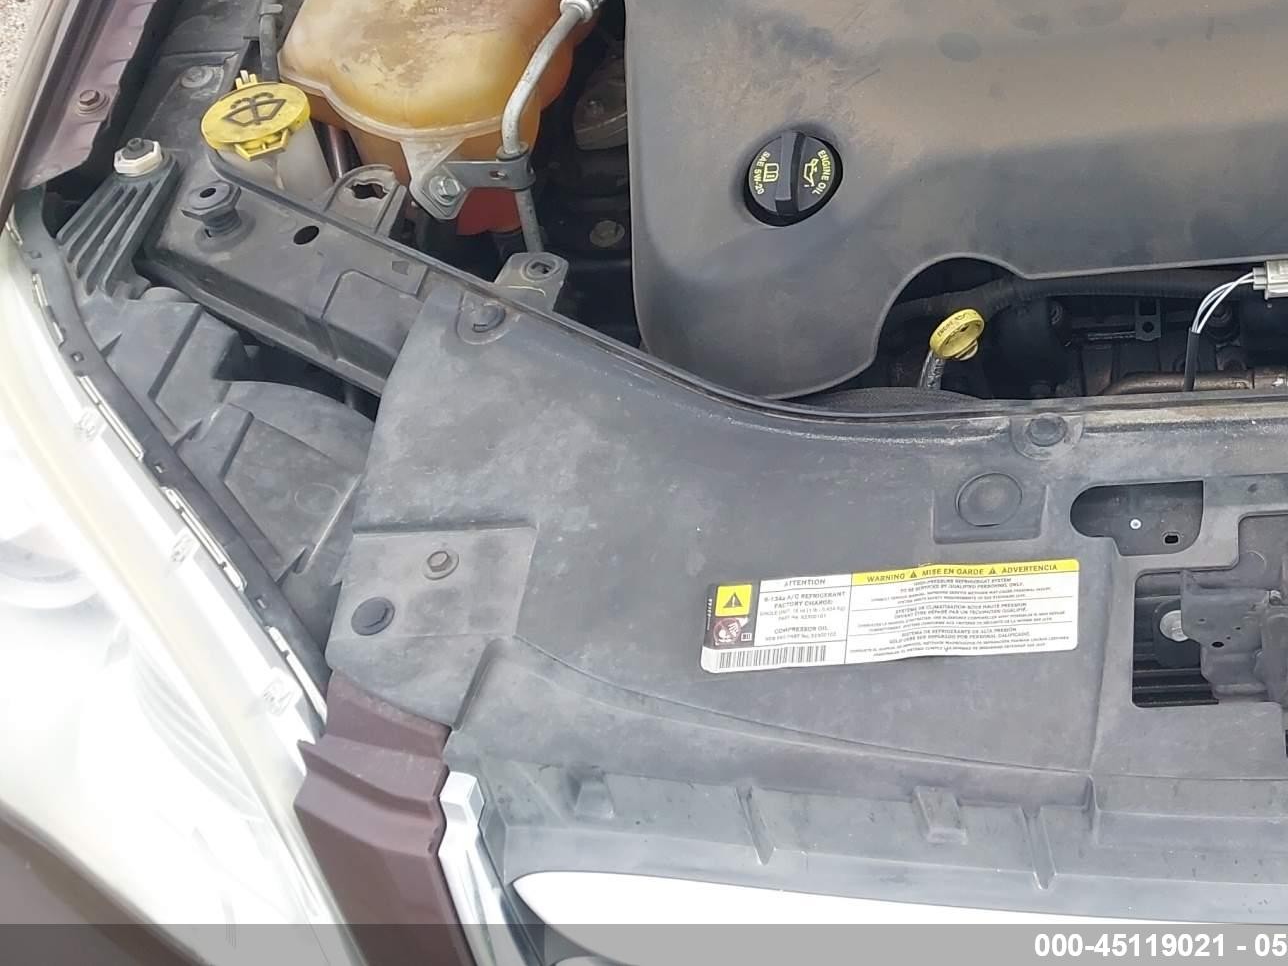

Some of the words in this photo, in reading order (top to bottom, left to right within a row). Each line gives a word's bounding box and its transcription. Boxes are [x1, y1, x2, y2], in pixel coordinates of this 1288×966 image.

[756, 151, 771, 167] SAE
[817, 150, 832, 181] ENGINE
[753, 168, 765, 195] 5W-20
[811, 182, 827, 195] OIL
[867, 573, 906, 582] WARNING
[921, 568, 941, 577] MISE
[956, 567, 984, 576] GARDE
[1001, 564, 1058, 574] ADVERTENCIA
[784, 579, 826, 587] ATTENTION
